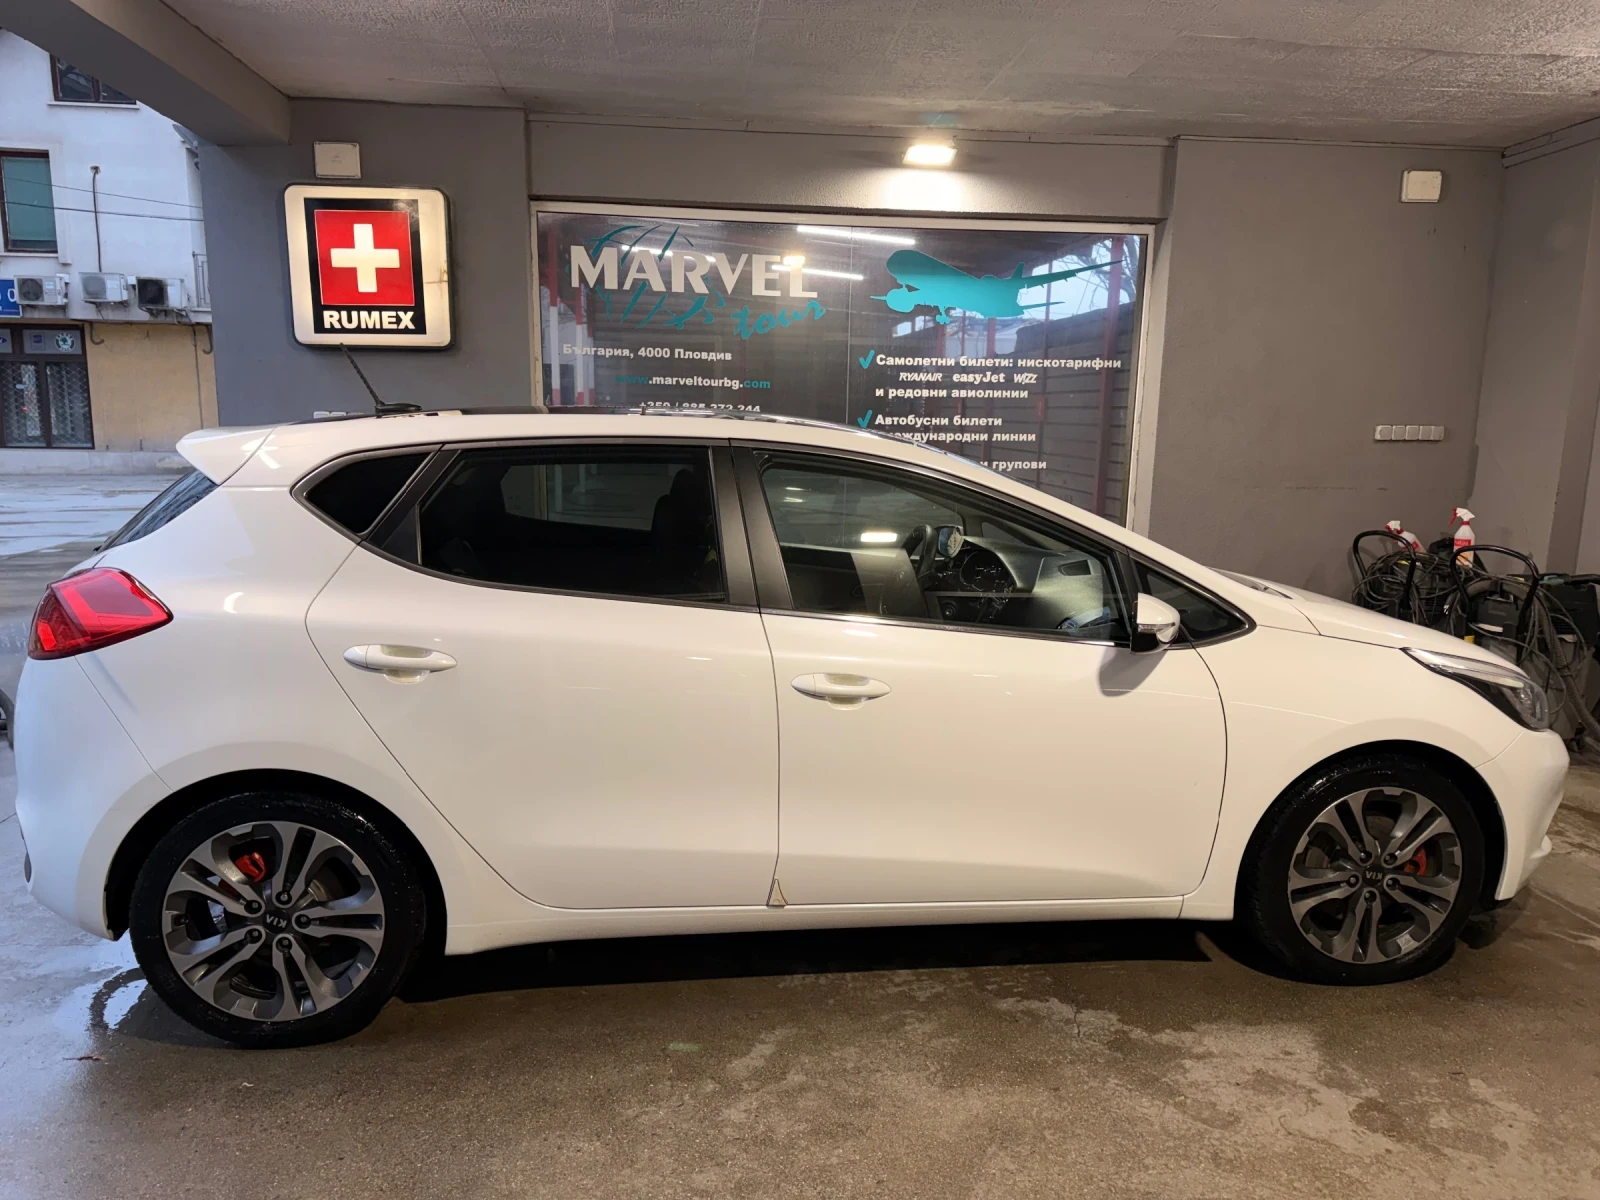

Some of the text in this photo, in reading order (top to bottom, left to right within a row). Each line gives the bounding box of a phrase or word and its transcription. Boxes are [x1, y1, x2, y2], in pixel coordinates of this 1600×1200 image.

[570, 245, 818, 298] MARVEL
[322, 310, 416, 330] RUMEX
[731, 300, 826, 340] tour
[563, 344, 732, 361] България, 4000 Пловдив
[876, 354, 1122, 370] Самолетни билети: нискотарифни
[614, 375, 771, 390] www.marveltourbg.com
[899, 372, 943, 382] RYANAIR
[952, 371, 1006, 384] easyJet
[875, 388, 1029, 400] и редовни авиолинии
[875, 414, 1002, 427] Автобусни билети
[992, 432, 1036, 442] линии
[992, 461, 1047, 471] групови
[266, 913, 288, 928] KIA
